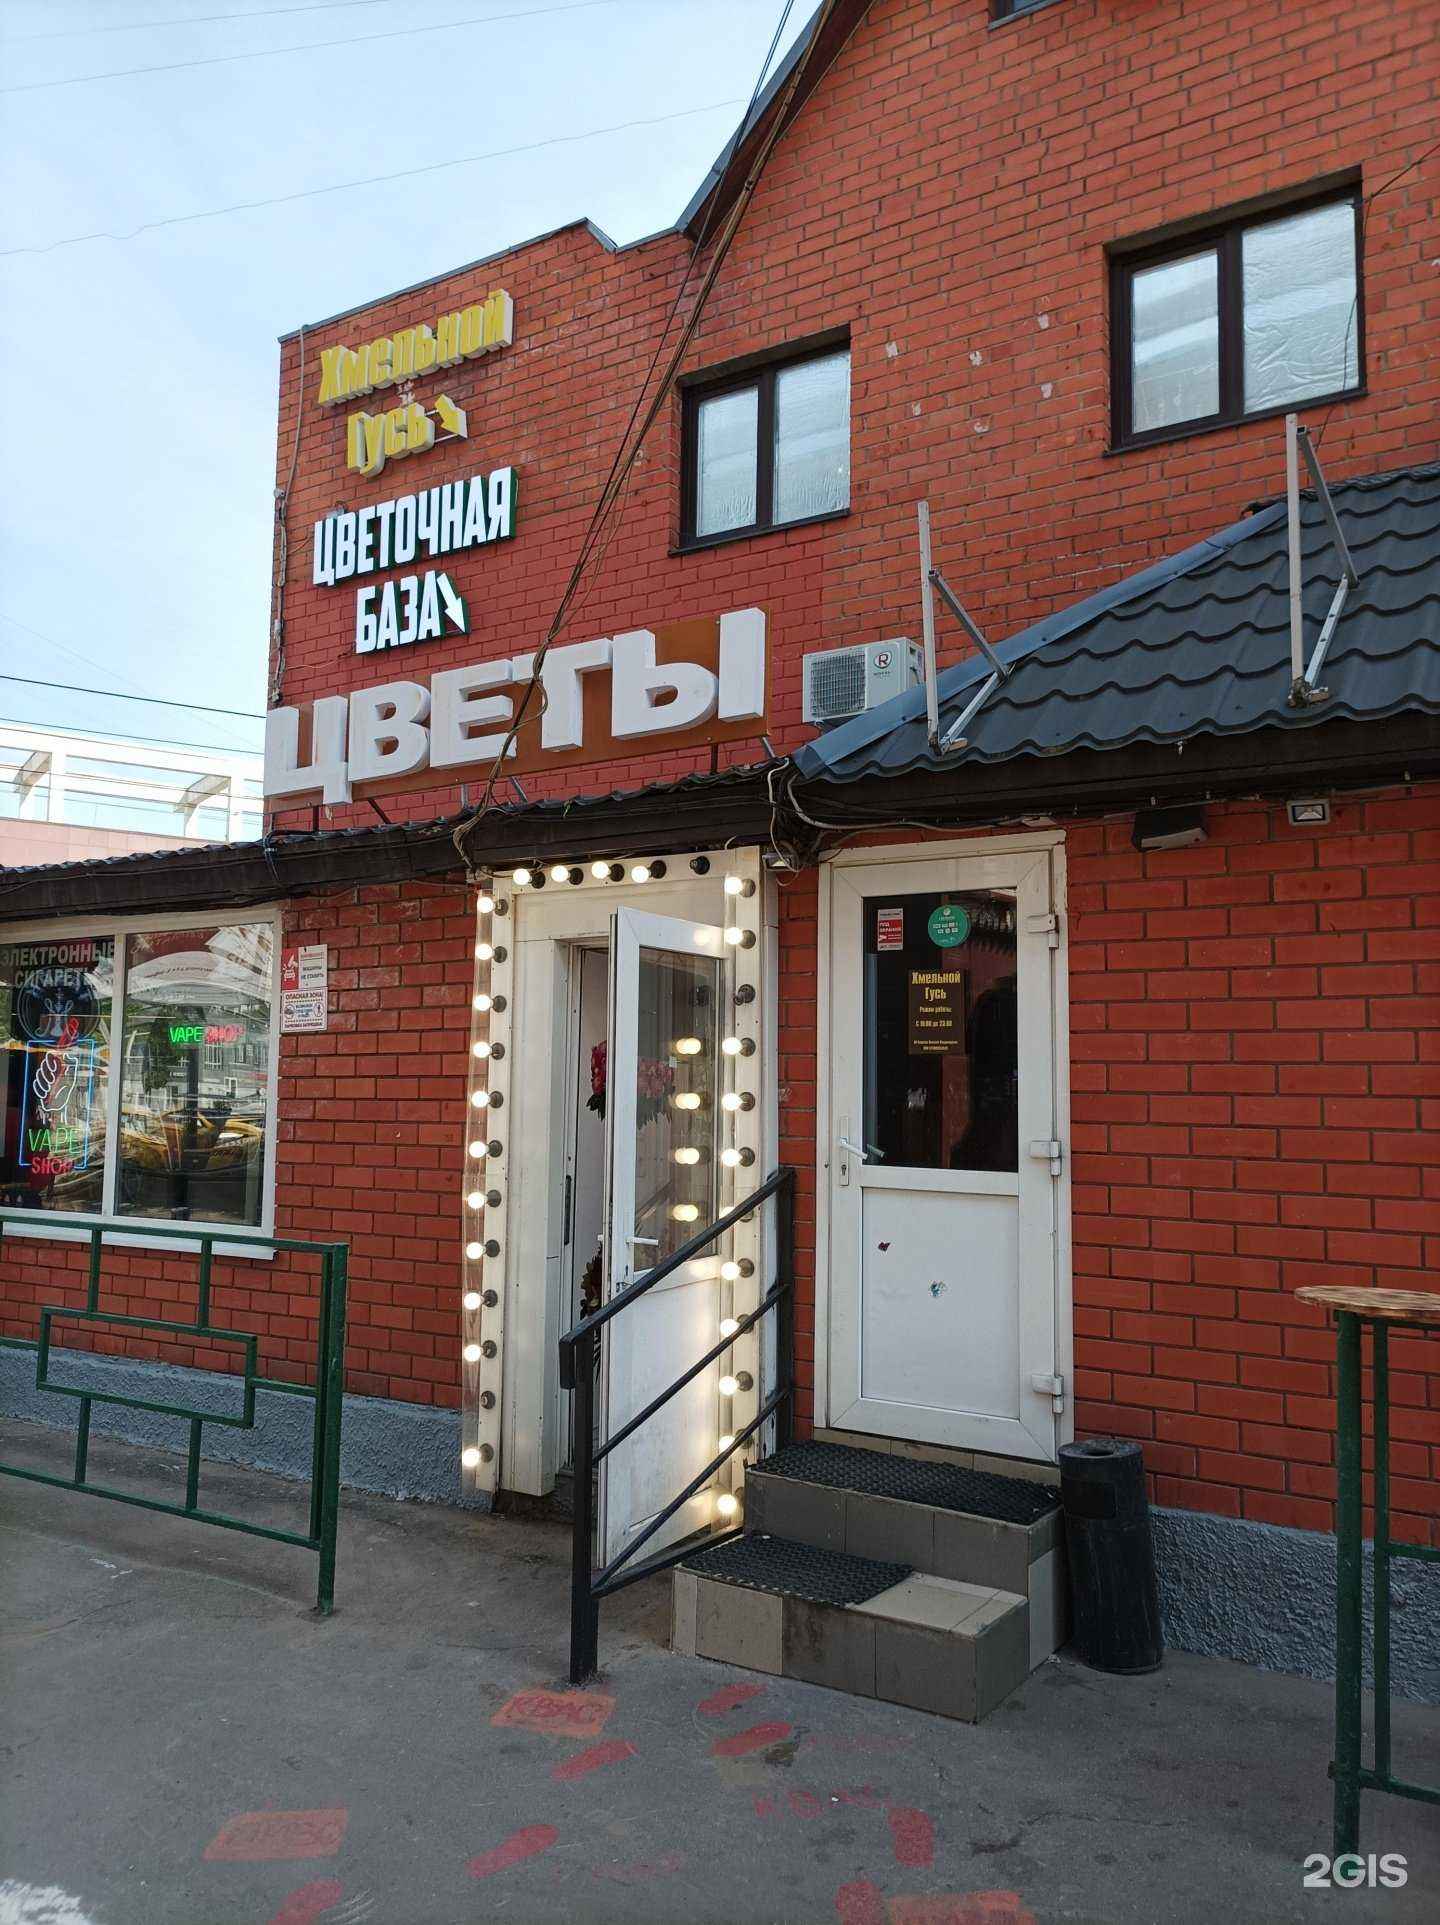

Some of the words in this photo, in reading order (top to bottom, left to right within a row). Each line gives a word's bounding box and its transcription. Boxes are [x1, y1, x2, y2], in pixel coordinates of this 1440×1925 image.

[318, 288, 514, 406] Хмельной
[347, 402, 436, 478] Гусь
[312, 466, 516, 587] ЦВЕТОЧНАЯ
[354, 569, 443, 655] БАЗА
[263, 606, 766, 806] ЦВЕТЫ
[911, 971, 961, 985] Хмельной
[924, 986, 947, 1002] Гусь
[169, 1026, 204, 1043] VAPE
[28, 1127, 82, 1154] VAPE
